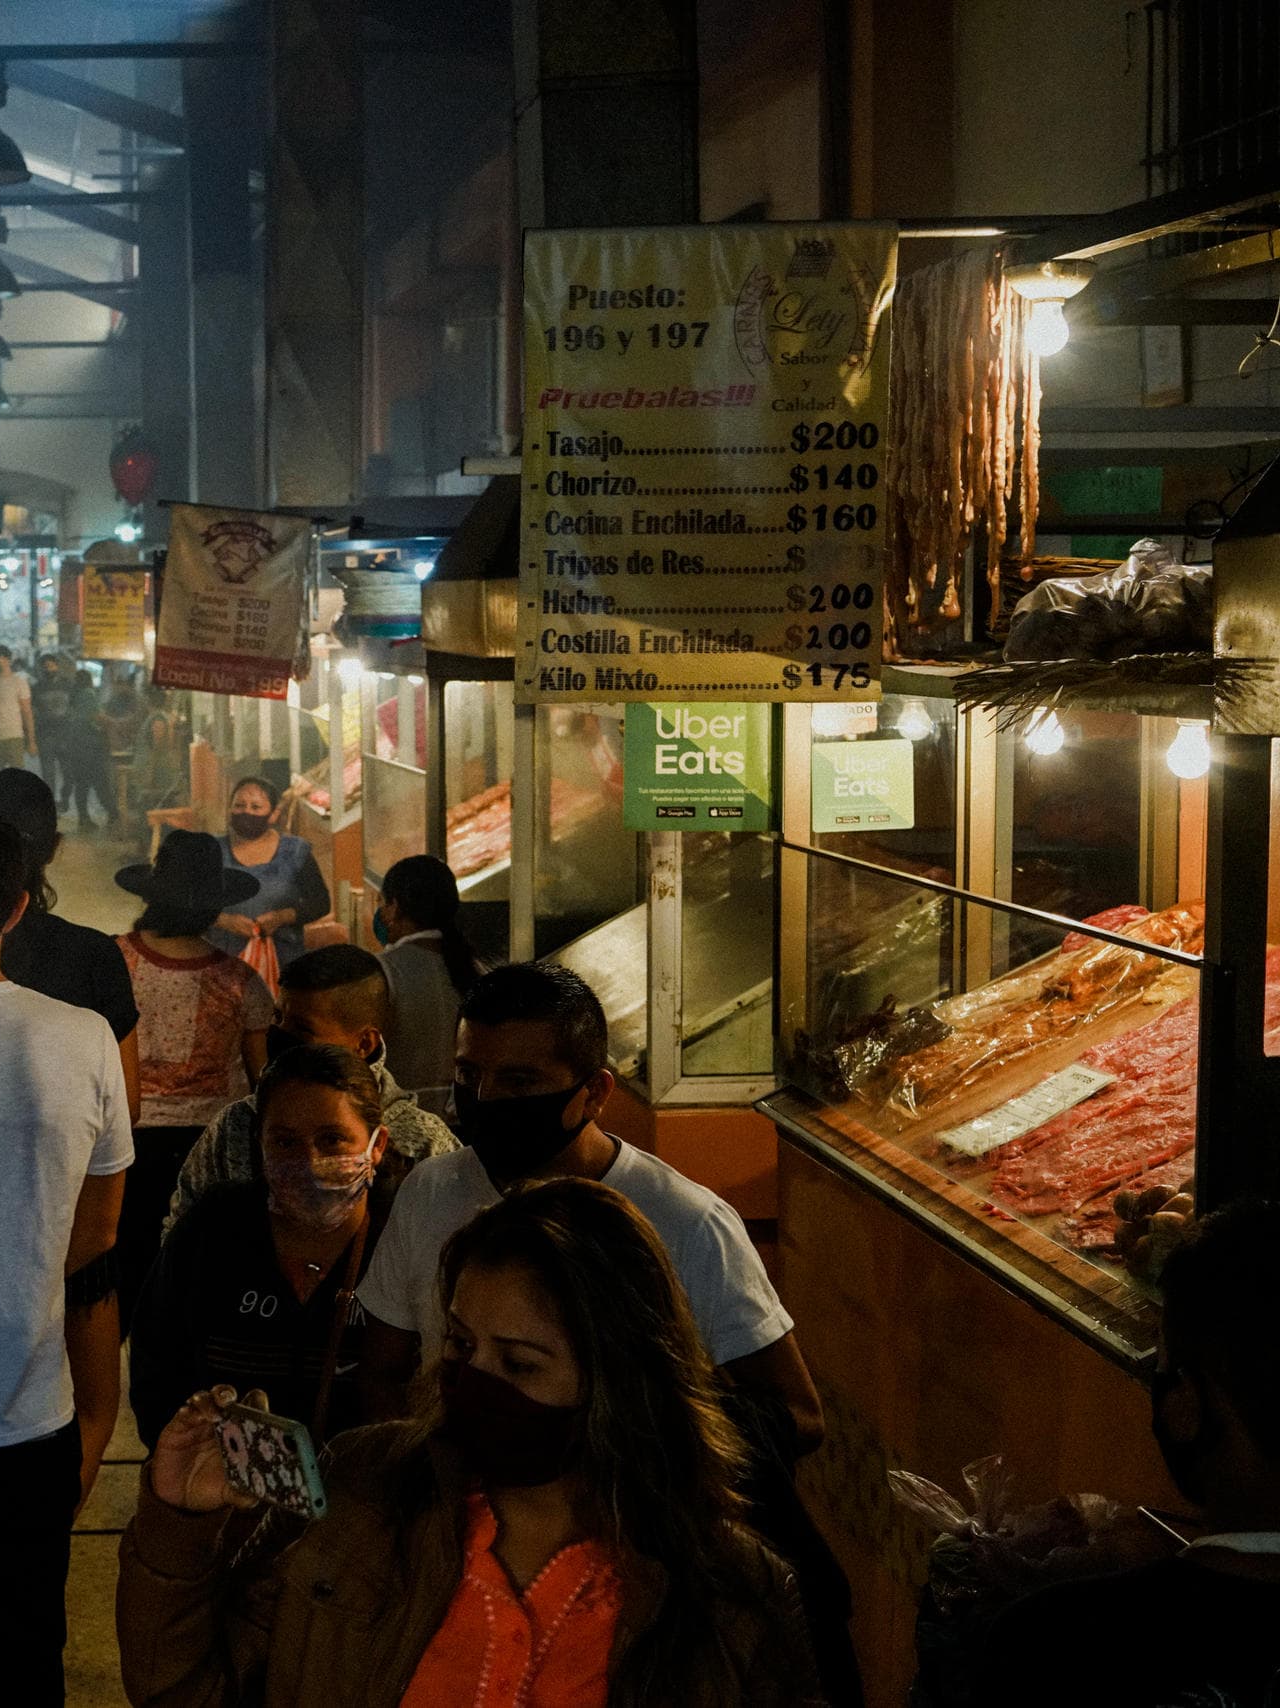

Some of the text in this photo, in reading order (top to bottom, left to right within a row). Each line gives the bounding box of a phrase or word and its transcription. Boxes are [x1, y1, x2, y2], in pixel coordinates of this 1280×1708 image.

[568, 284, 686, 311] Puesto:
[544, 322, 710, 356] 196 y 197
[780, 350, 829, 366] Sabor
[539, 384, 756, 410] Pruebalas!!!
[802, 377, 812, 392] y
[771, 396, 837, 412] Calidad
[546, 421, 879, 461] Tasajo $200
[545, 463, 879, 497] Chorizo $140
[544, 503, 877, 536] Cecina Enchilada $160
[543, 549, 619, 579] Tripas
[626, 549, 652, 574] de
[662, 550, 703, 575] Res
[542, 582, 873, 616] Hubre $200
[540, 621, 871, 655] Costilla Enchilada $200
[159, 668, 204, 687] Local
[539, 662, 871, 692] Kilo Mixto $175
[656, 708, 747, 739] Uber
[656, 744, 745, 775] Eats
[833, 753, 888, 774] Uber
[833, 777, 890, 798] Eats
[239, 1290, 278, 1318] 90
